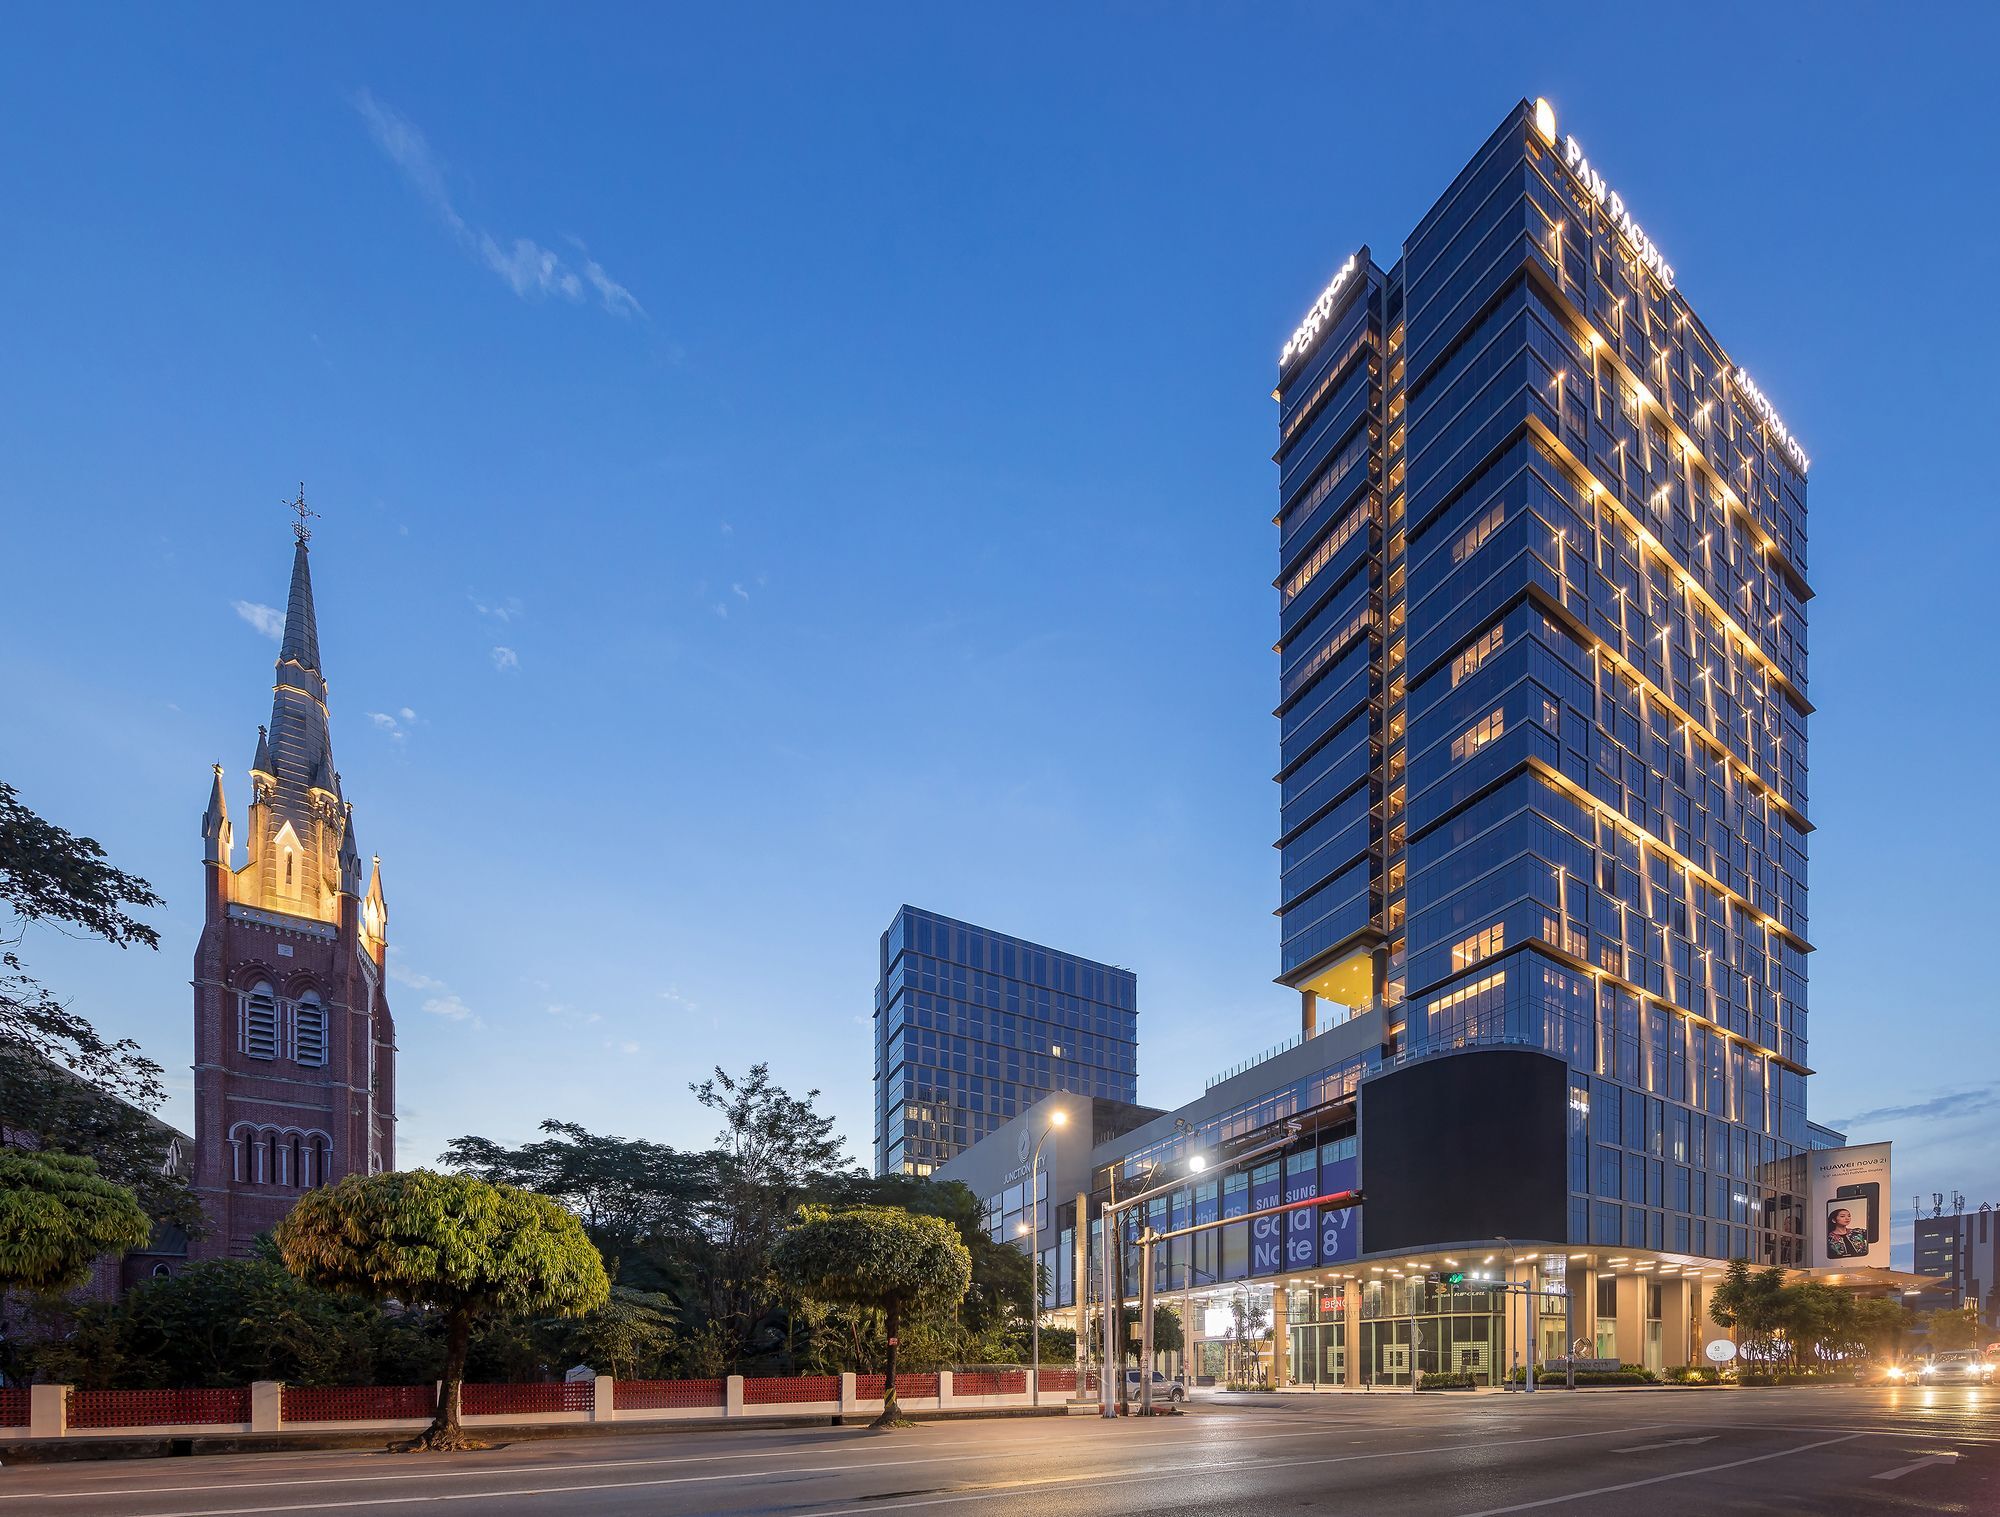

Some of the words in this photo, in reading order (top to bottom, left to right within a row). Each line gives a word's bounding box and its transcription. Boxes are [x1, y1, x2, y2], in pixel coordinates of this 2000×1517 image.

[1566, 134, 1606, 205] PAN
[1609, 190, 1675, 291] PACIFIC
[1734, 367, 1787, 445] JUNCTION
[1787, 436, 1809, 473] CITY
[1003, 1161, 1031, 1185] JUNCTION
[1820, 1162, 1855, 1171] HUAWEI
[1857, 1159, 1878, 1167] nova
[1256, 1184, 1316, 1210] SAMSUNG
[1253, 1207, 1352, 1239] Galaxy
